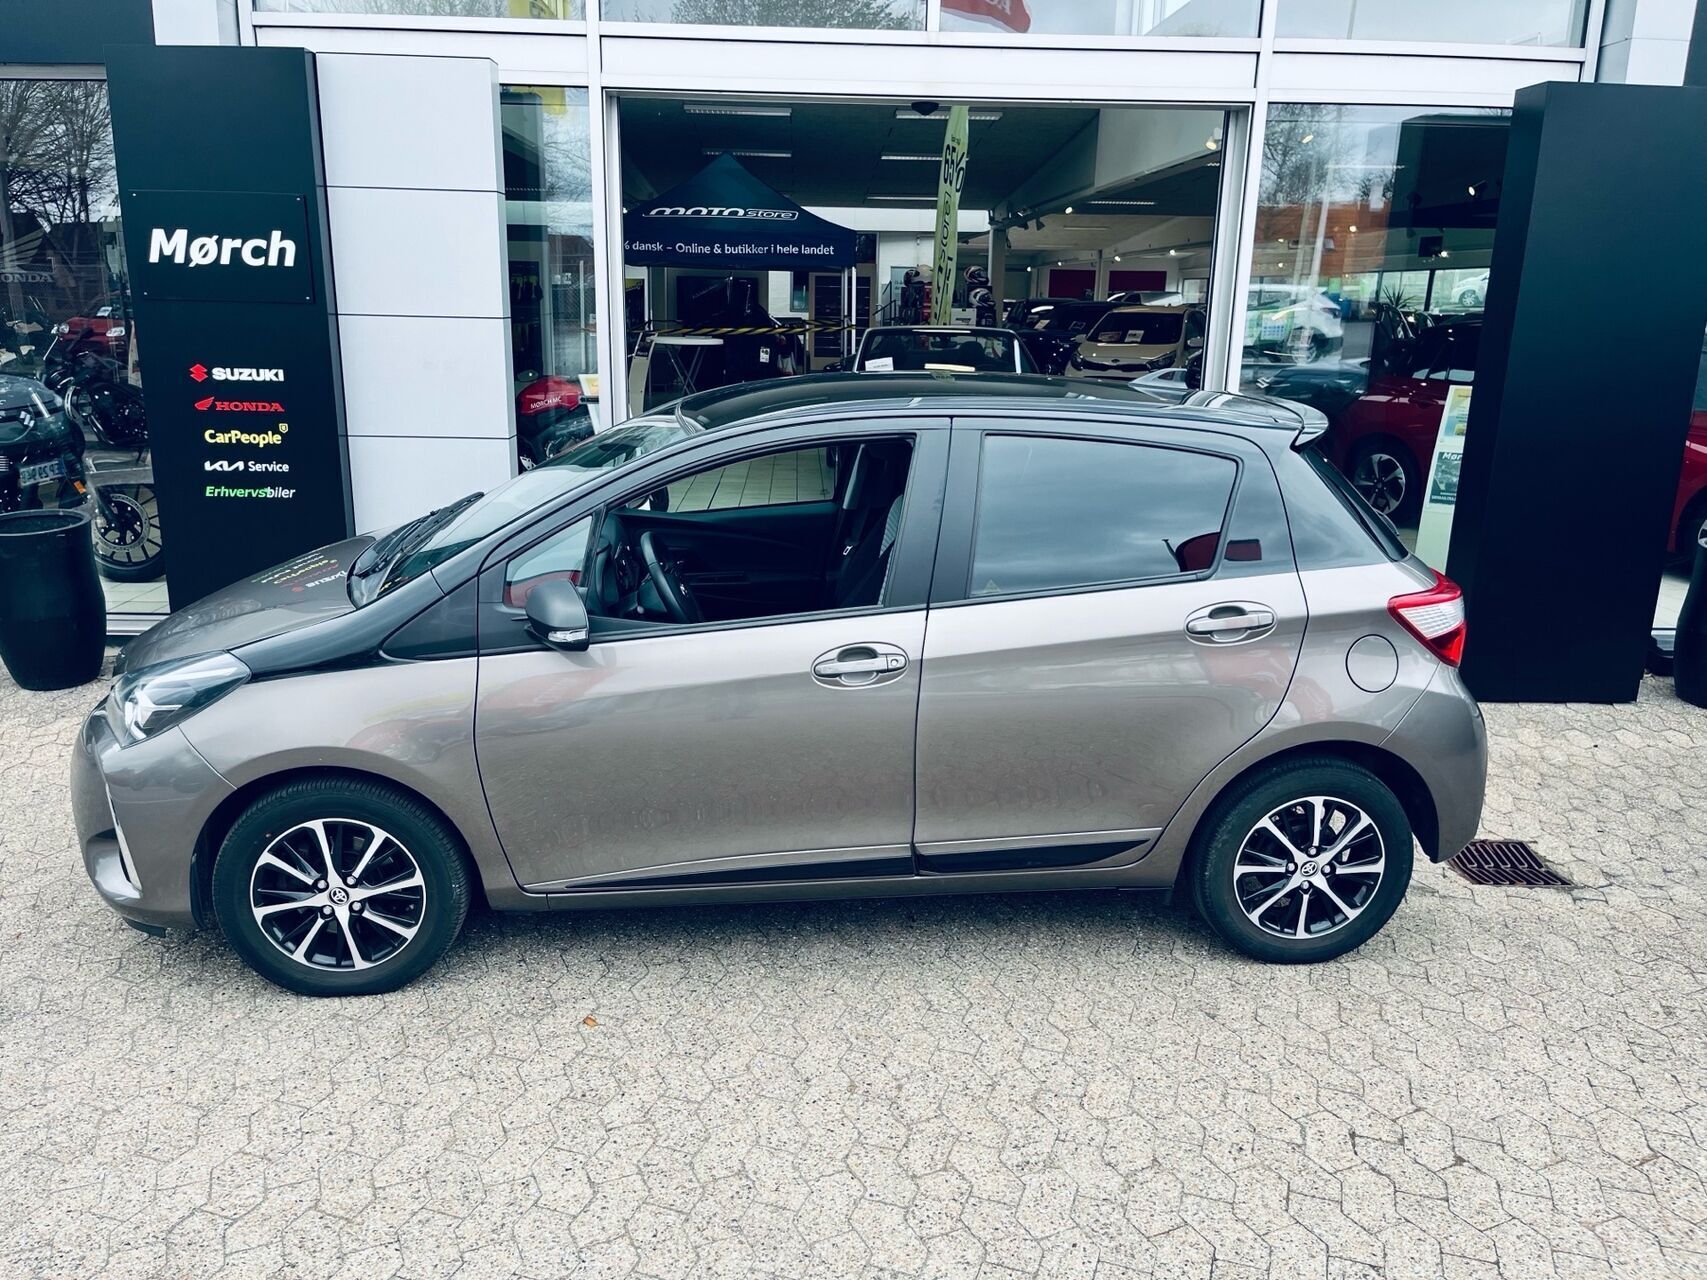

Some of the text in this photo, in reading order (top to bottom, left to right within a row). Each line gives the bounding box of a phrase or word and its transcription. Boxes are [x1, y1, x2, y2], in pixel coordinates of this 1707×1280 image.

[149, 228, 296, 267] Mørch
[632, 241, 664, 252] dansk
[675, 242, 712, 254] Online
[713, 243, 722, 254] &
[724, 243, 769, 255] butikker
[776, 244, 799, 255] hele
[801, 244, 834, 255] landet
[211, 367, 285, 382] SUZUKI
[215, 401, 285, 412] HONDA
[204, 429, 282, 448] CarPeople
[248, 461, 290, 472] Service
[205, 486, 296, 498] Erhvervsbiler
